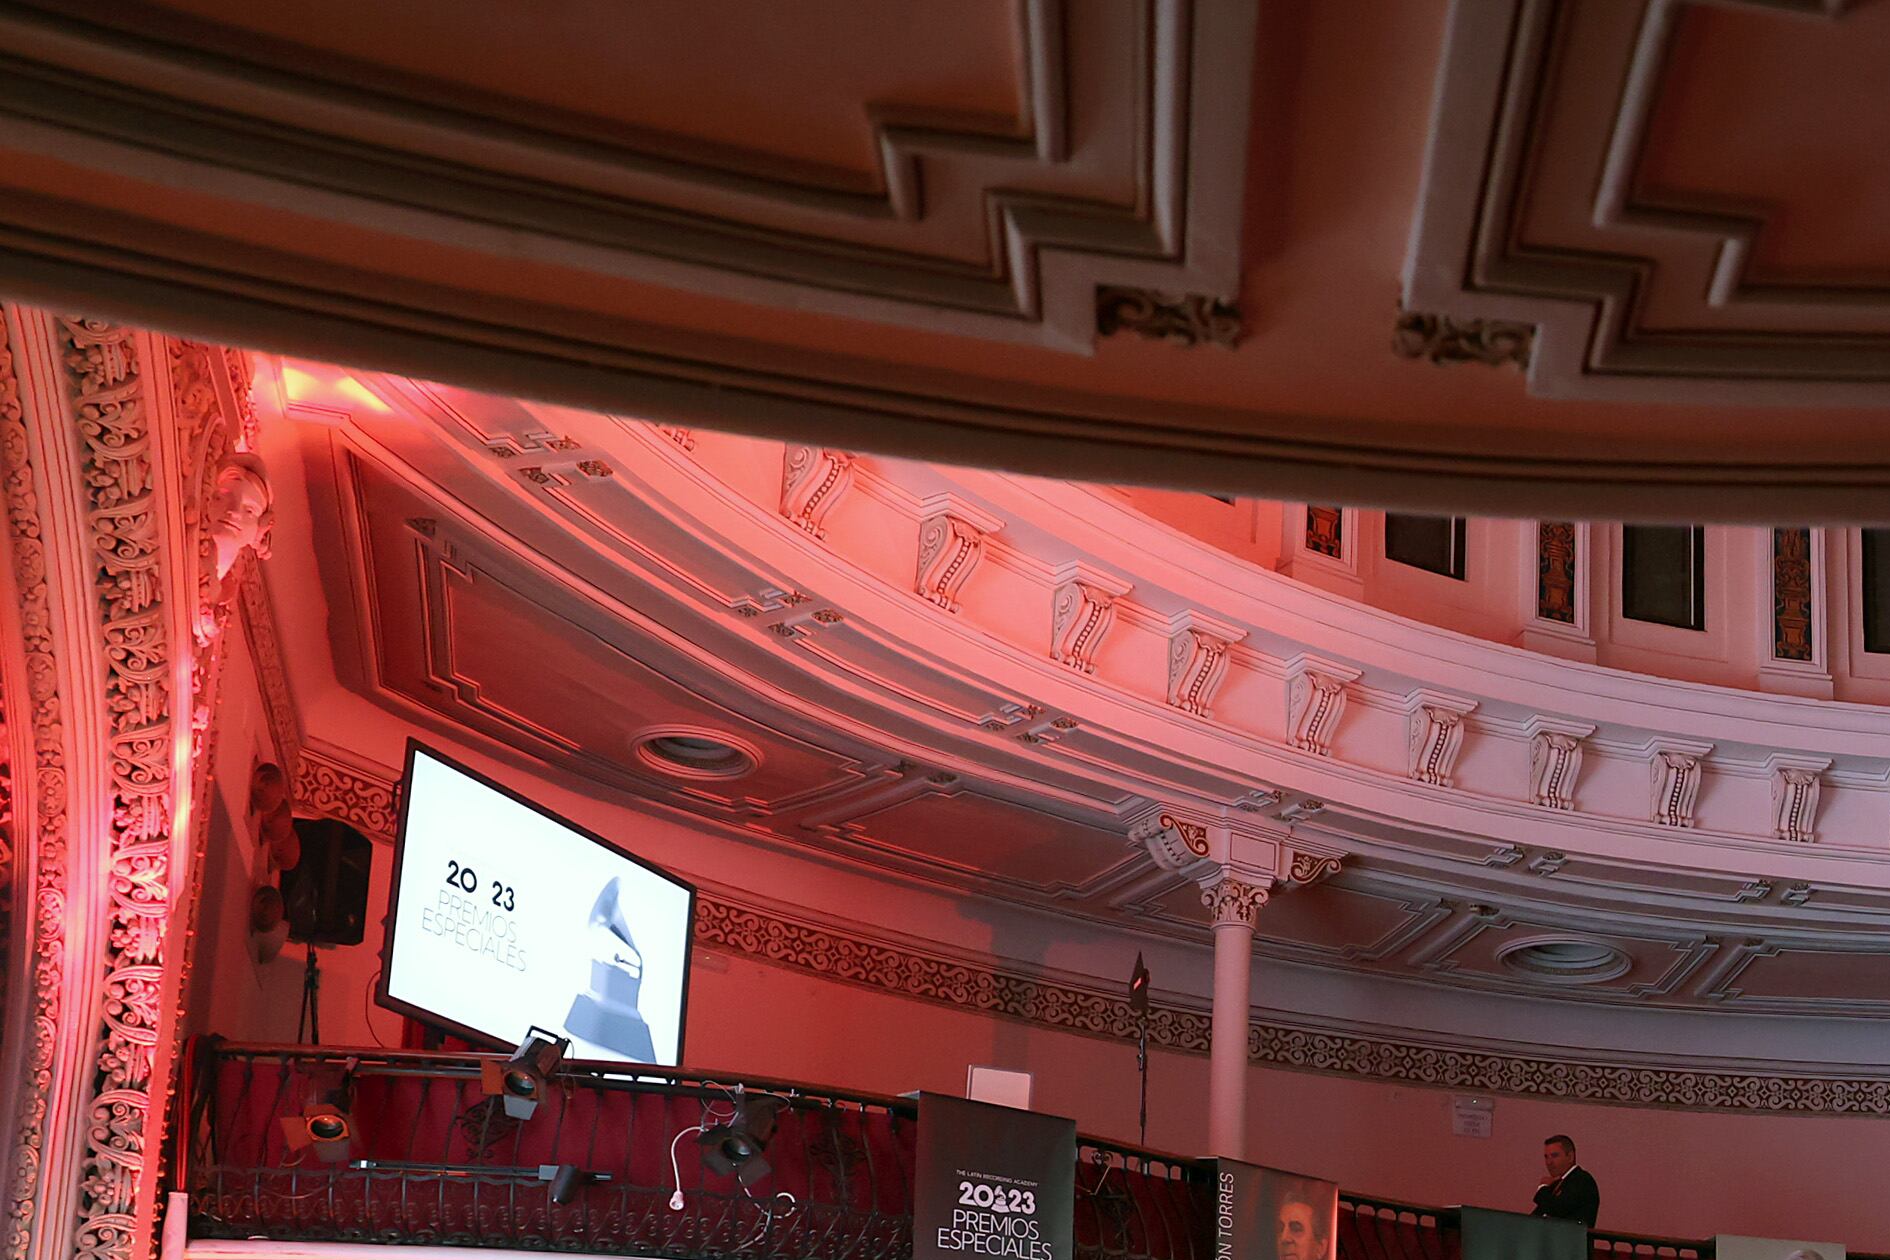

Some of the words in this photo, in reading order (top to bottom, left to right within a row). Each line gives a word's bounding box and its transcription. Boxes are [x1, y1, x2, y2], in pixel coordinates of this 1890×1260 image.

[422, 907, 527, 972] ESPECIALES
[438, 889, 517, 944] PREMIOS
[952, 1208, 1040, 1241] PREMIOS
[1218, 1171, 1234, 1238] TORRES
